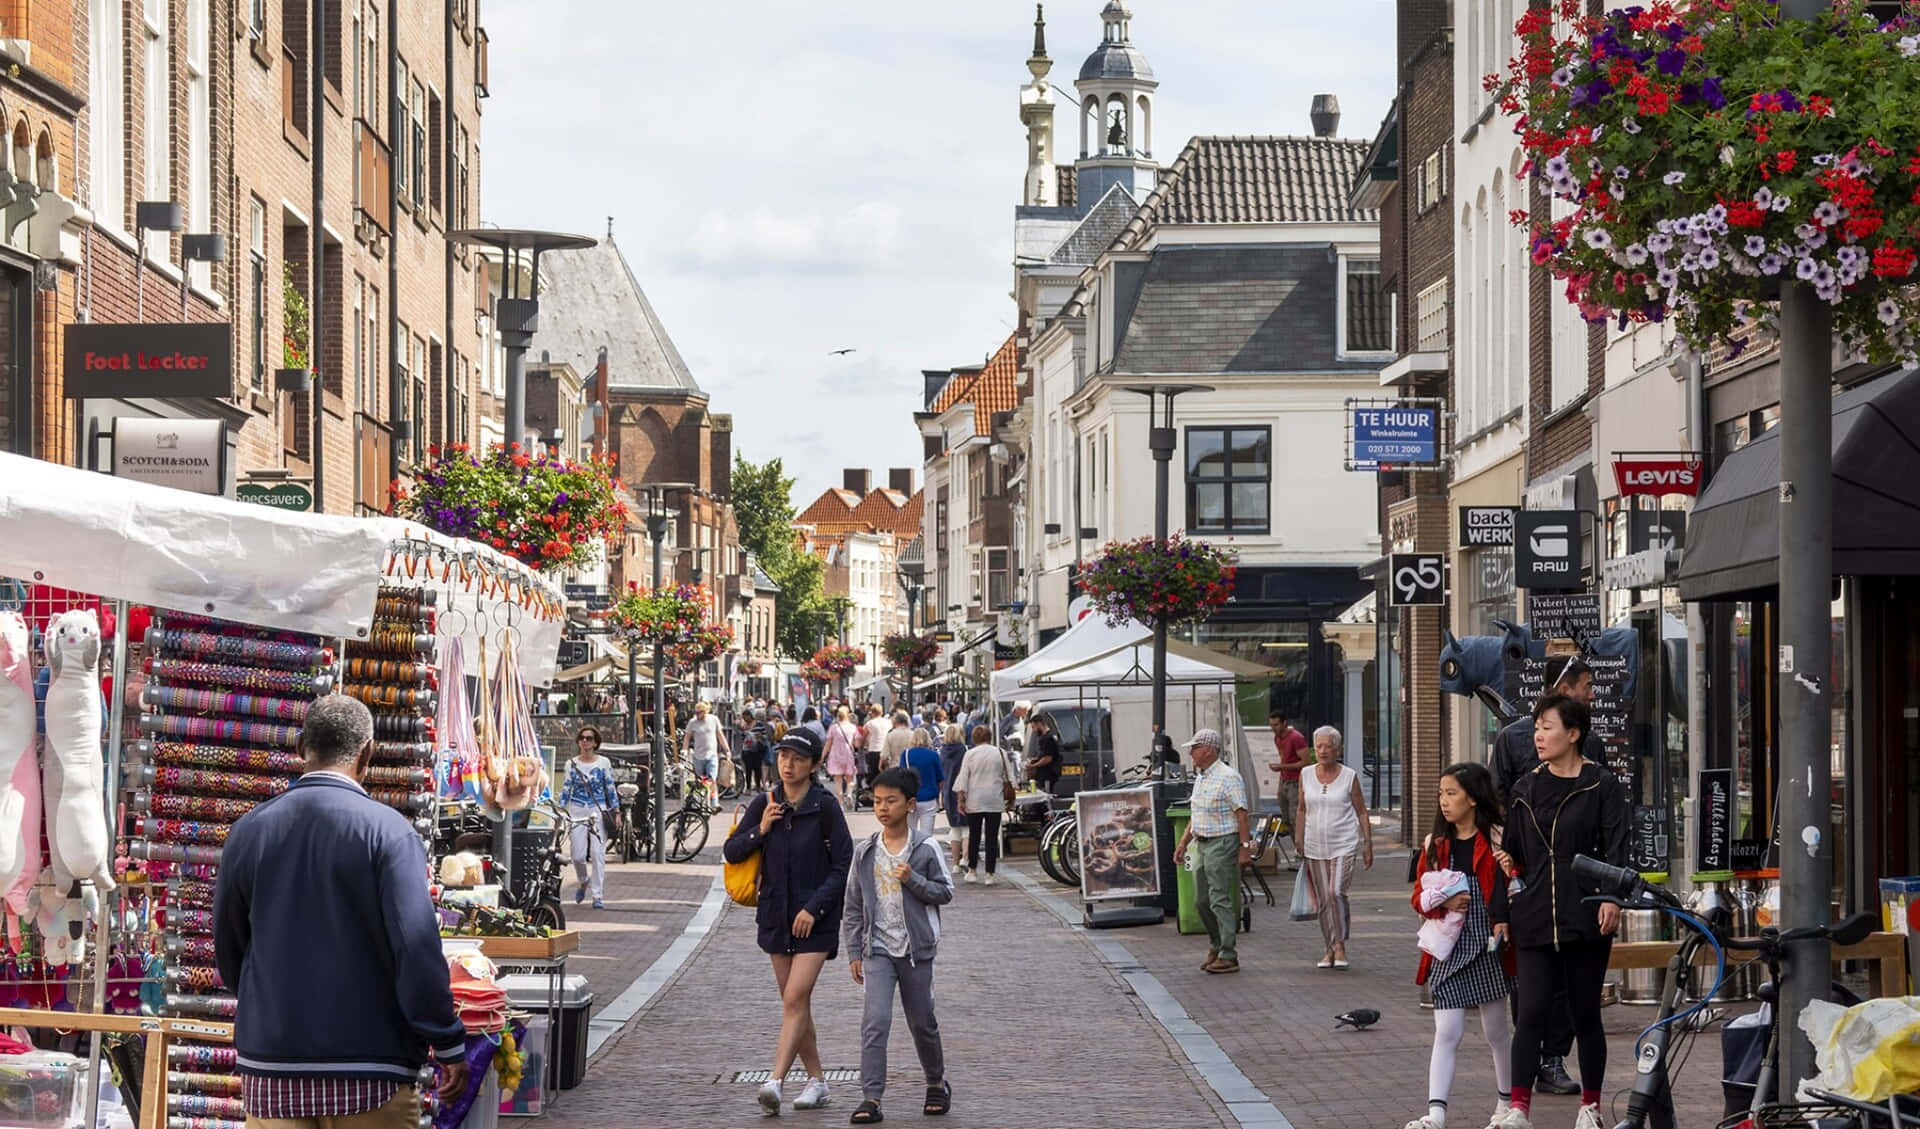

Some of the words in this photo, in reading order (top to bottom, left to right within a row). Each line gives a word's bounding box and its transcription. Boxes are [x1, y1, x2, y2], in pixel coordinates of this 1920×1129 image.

[85, 352, 131, 370] Foot
[137, 352, 209, 369] Locker
[1360, 412, 1380, 426] TE
[1384, 412, 1429, 427] HUUR
[1368, 445, 1383, 453] 020
[1385, 445, 1399, 453] 571
[1401, 445, 1421, 453] 2000
[122, 456, 209, 466] SCOTCH&SODA
[1470, 510, 1511, 525] back
[1467, 528, 1513, 543] WERK
[1532, 562, 1569, 572] RAW
[1395, 558, 1440, 602] 95
